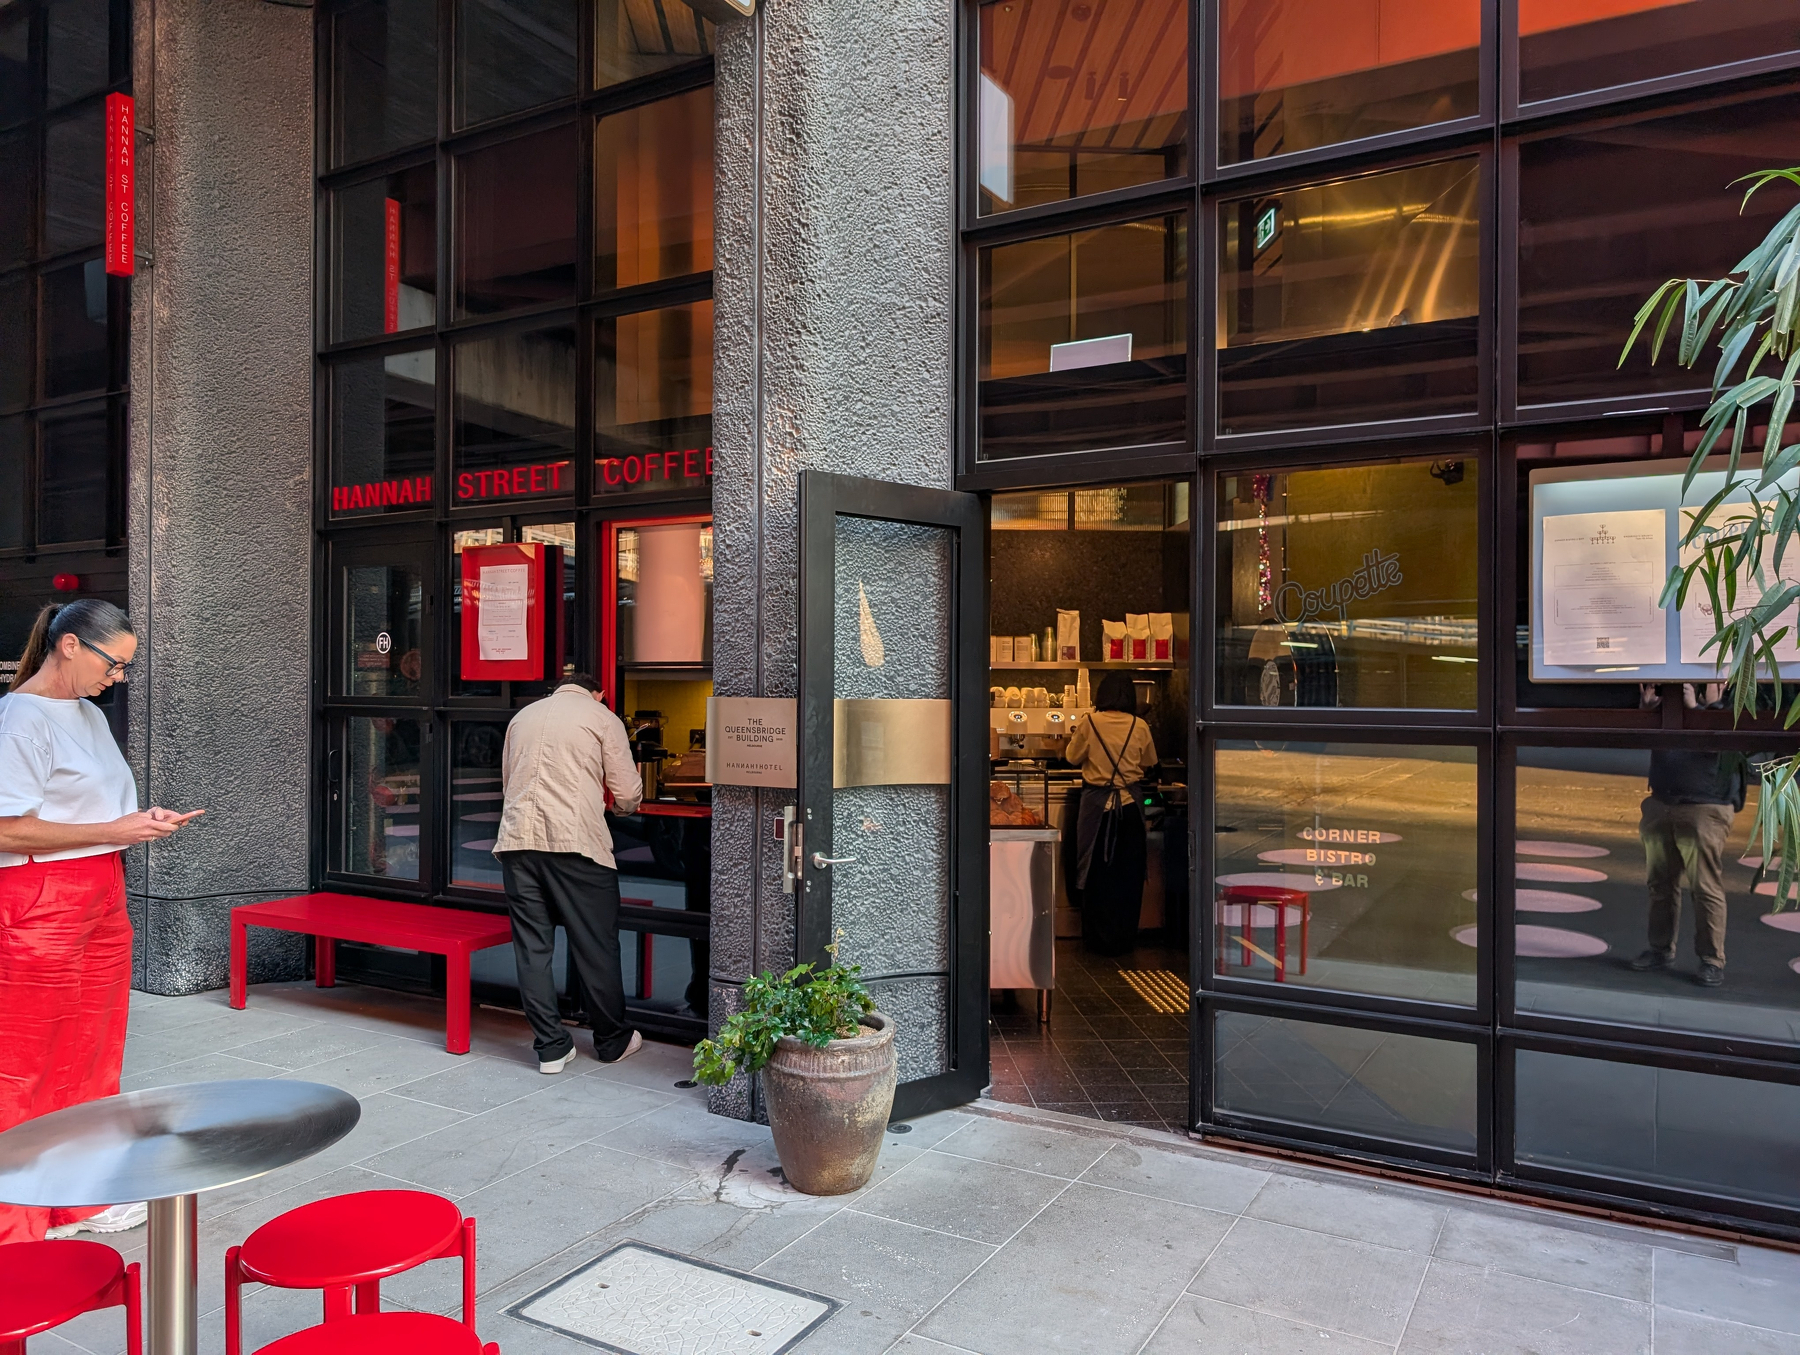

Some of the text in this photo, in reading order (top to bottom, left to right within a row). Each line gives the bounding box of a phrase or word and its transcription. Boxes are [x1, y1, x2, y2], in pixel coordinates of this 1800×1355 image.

[121, 104, 129, 264] HANNAH ST COFFEE
[333, 476, 432, 511] HANNAH
[457, 463, 566, 499] STREET
[1273, 548, 1403, 640] Coupette
[0, 661, 20, 671] OMBINE
[724, 726, 786, 735] QUEENSBRIDGE
[747, 718, 763, 726] THE
[736, 734, 774, 743] BUILDING
[759, 763, 783, 771] HOTEL
[1302, 826, 1381, 844] CORNER
[1306, 849, 1376, 866] BISTRO
[1314, 869, 1369, 889] & BAR
